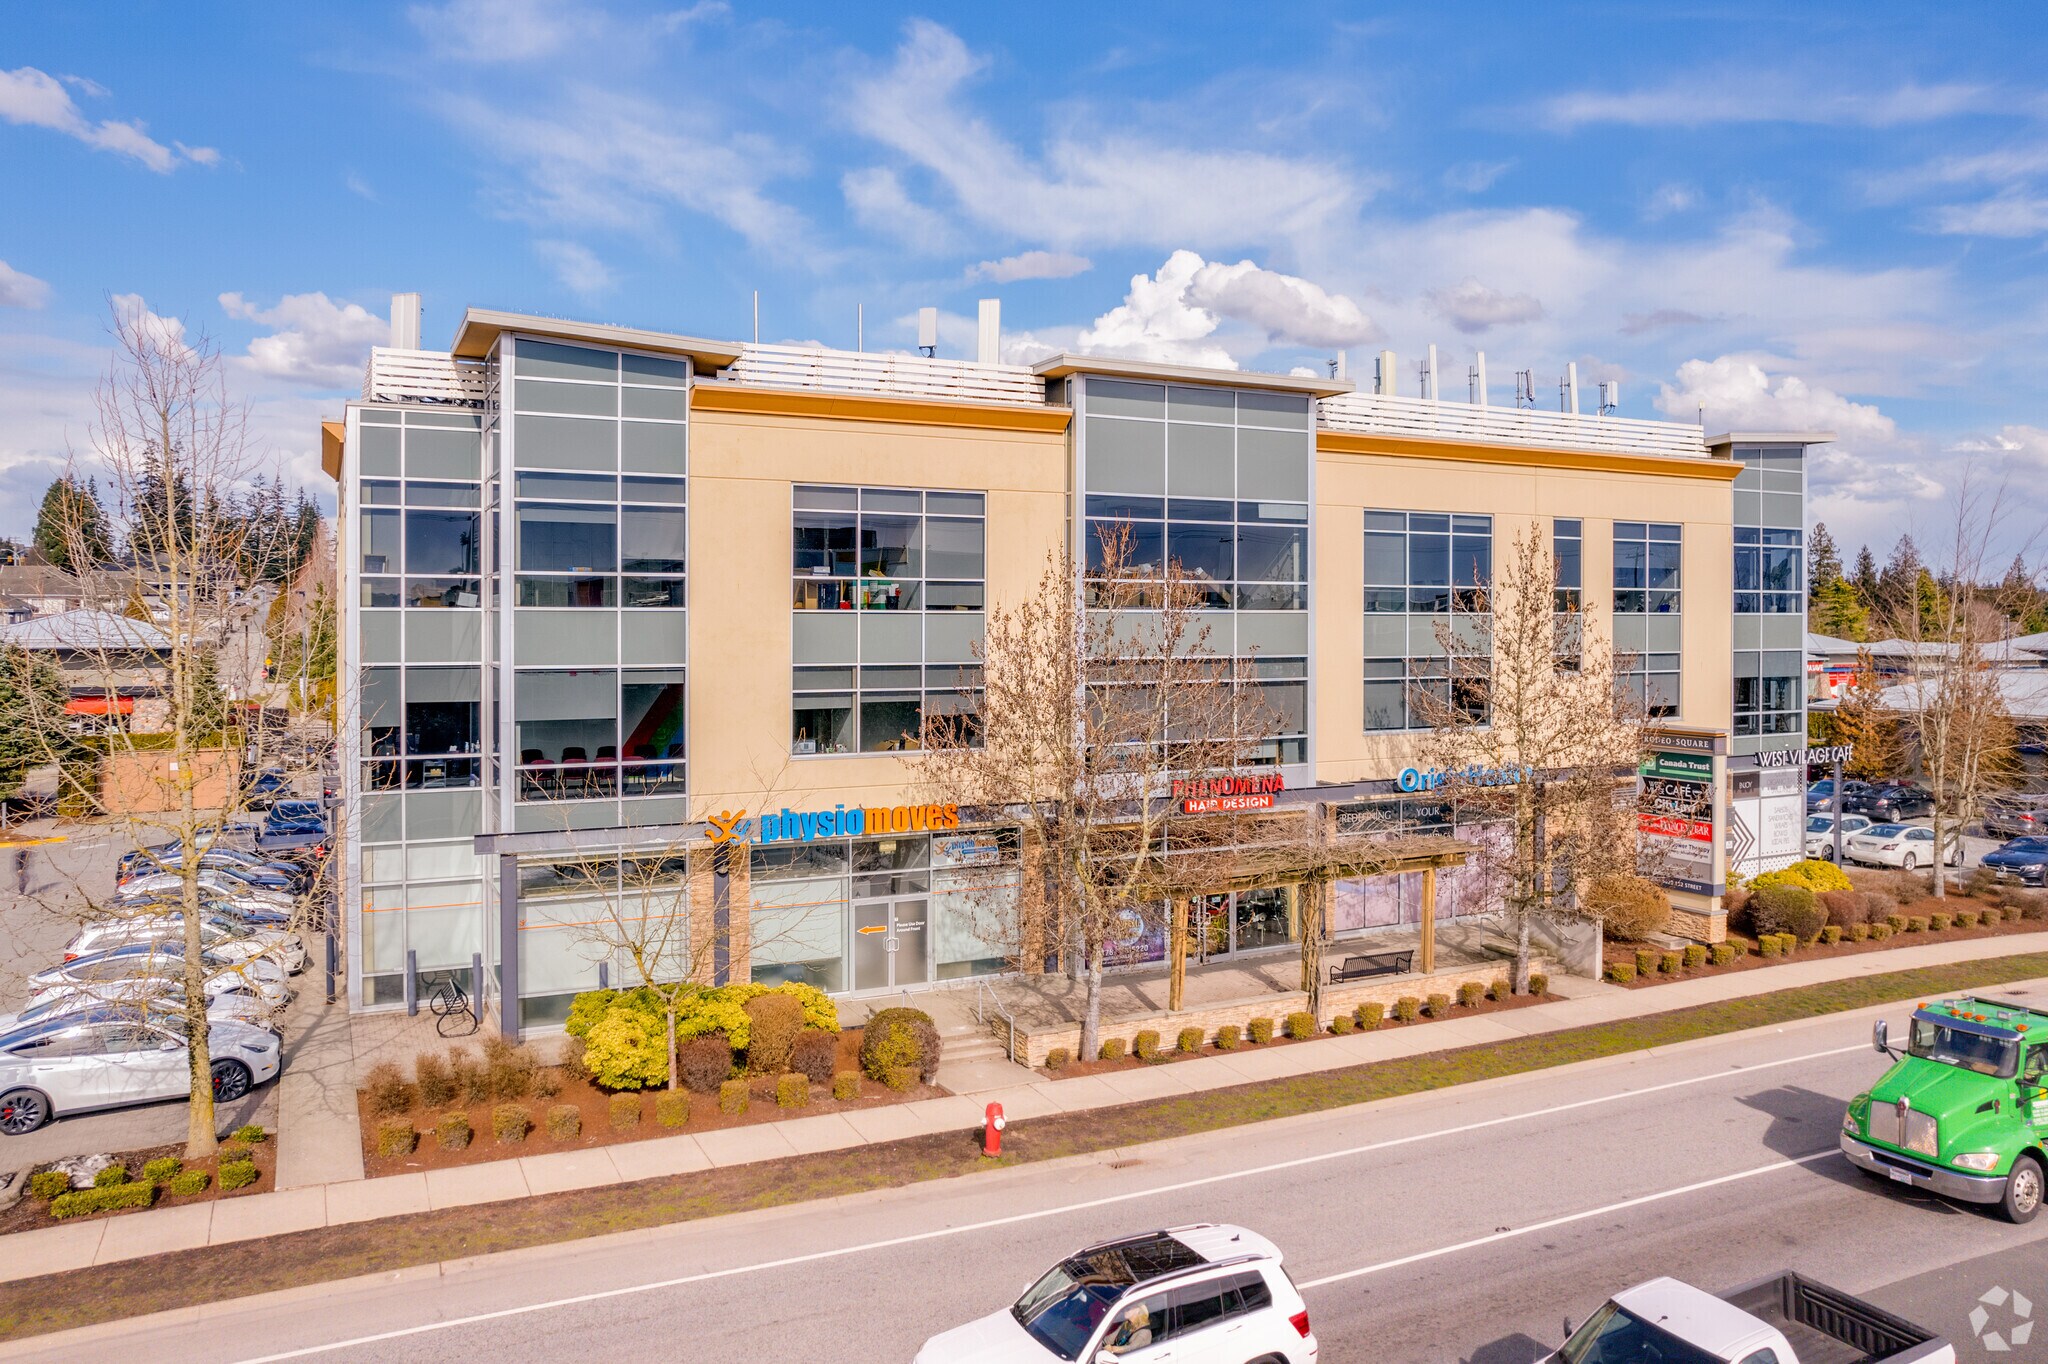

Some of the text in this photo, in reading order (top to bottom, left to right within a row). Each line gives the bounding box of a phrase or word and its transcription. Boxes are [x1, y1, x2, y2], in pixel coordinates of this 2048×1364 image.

[1644, 736, 1709, 748] RODEO SQUARE
[1660, 759, 1687, 768] Canada
[1688, 762, 1710, 771] Trust
[1758, 750, 1787, 767] WEST
[1173, 773, 1285, 797] PHENOMENA
[1665, 784, 1691, 797] CAFÉ
[1189, 797, 1269, 811] HAIR DESIGN
[1416, 807, 1440, 818] YOUR
[760, 803, 959, 844] physiomoves
[1684, 883, 1702, 891] STREET
